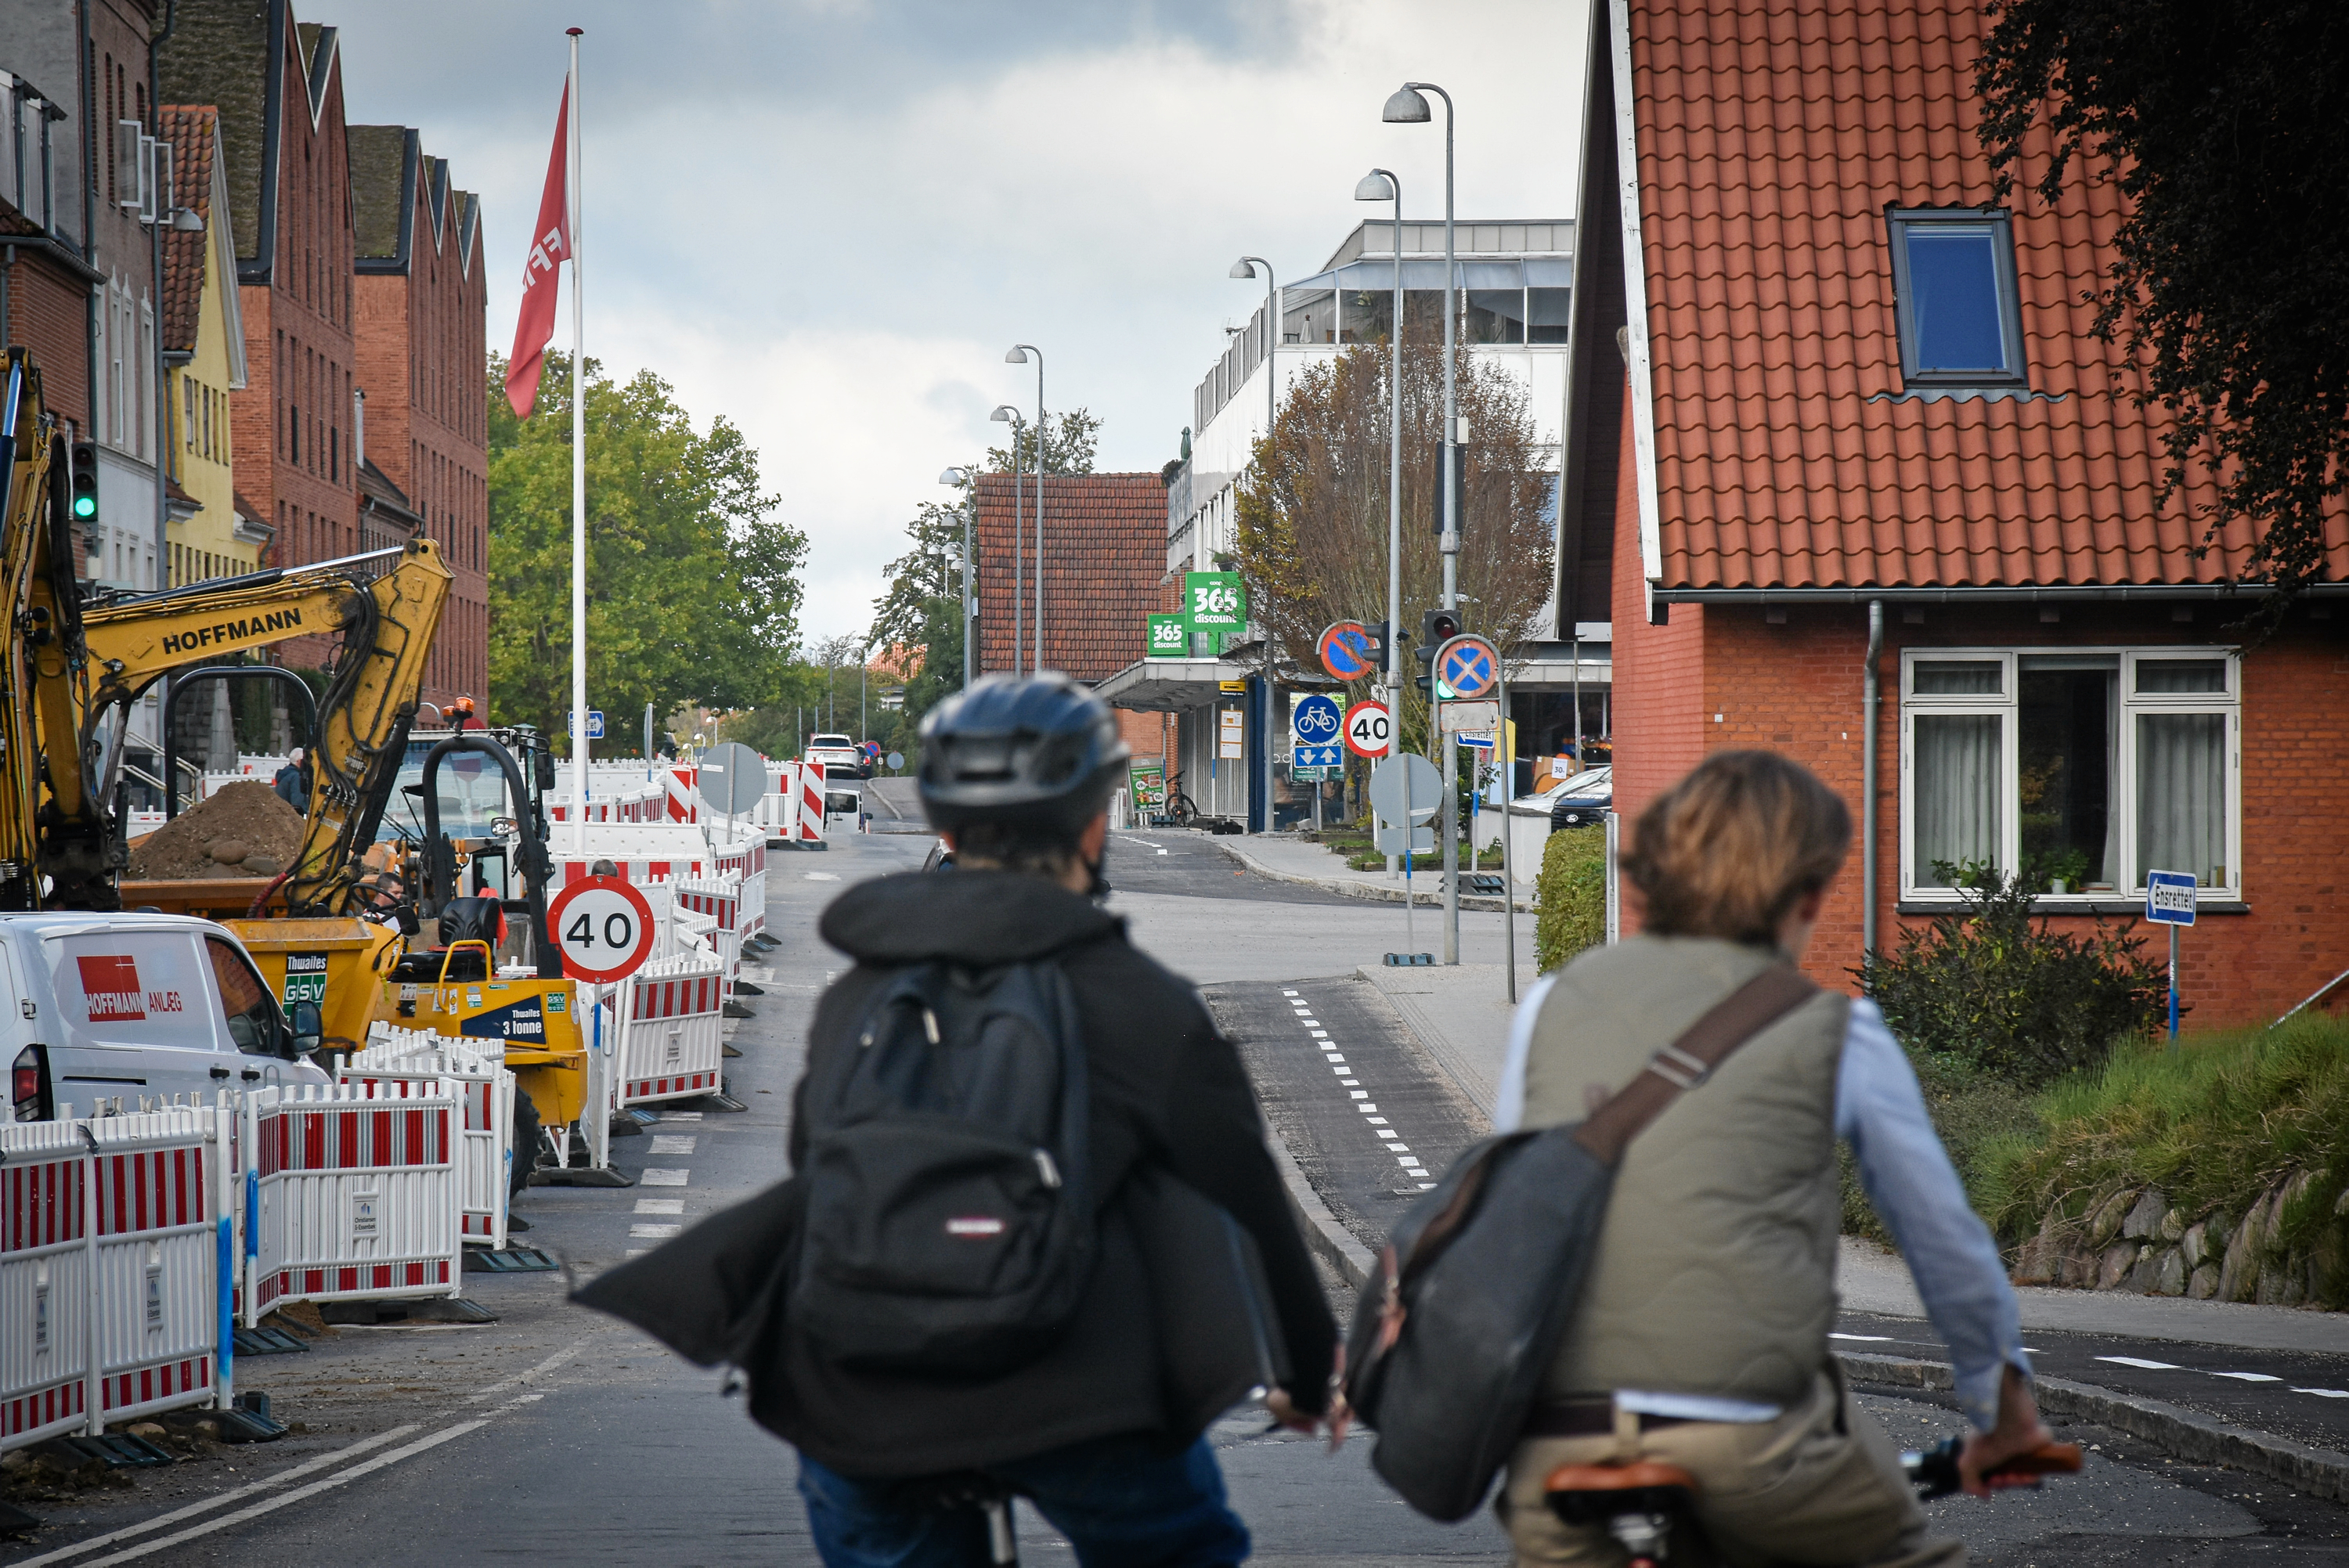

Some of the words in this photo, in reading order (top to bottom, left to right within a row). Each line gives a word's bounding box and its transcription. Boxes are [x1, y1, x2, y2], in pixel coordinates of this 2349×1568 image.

[1194, 587, 1238, 613] 365
[1194, 613, 1237, 623] discount
[162, 607, 302, 654] HOFFMANN
[1153, 625, 1183, 641] 365
[1352, 717, 1389, 741] 40
[2155, 885, 2192, 909] Ensrettet
[566, 912, 631, 949] 40
[287, 955, 327, 970] Thwaites
[285, 983, 324, 1000] GSV
[86, 992, 144, 1015] HOFFMANN
[149, 991, 182, 1012] ANLÆG
[512, 1009, 540, 1018] Thwaites
[503, 1020, 511, 1036] 3
[513, 1020, 542, 1035] tonne
